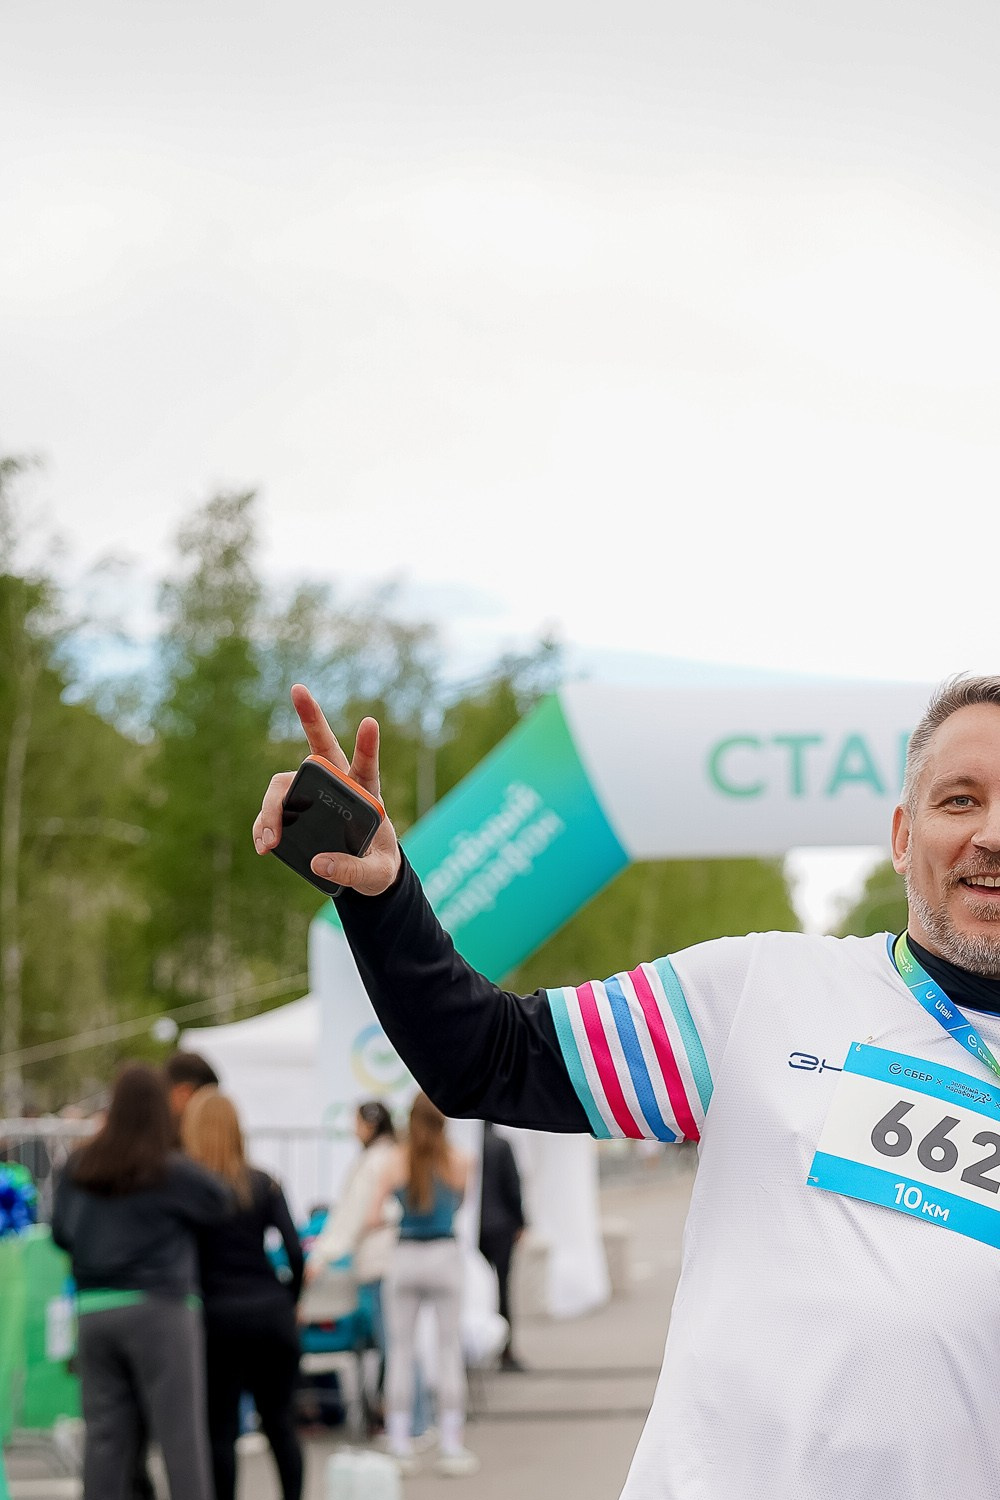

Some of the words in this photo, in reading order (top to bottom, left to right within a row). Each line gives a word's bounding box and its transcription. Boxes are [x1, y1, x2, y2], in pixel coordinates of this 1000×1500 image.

[317, 789, 353, 821] 12:10
[934, 1000, 954, 1020] Utair
[904, 1068, 933, 1082] СБЕР
